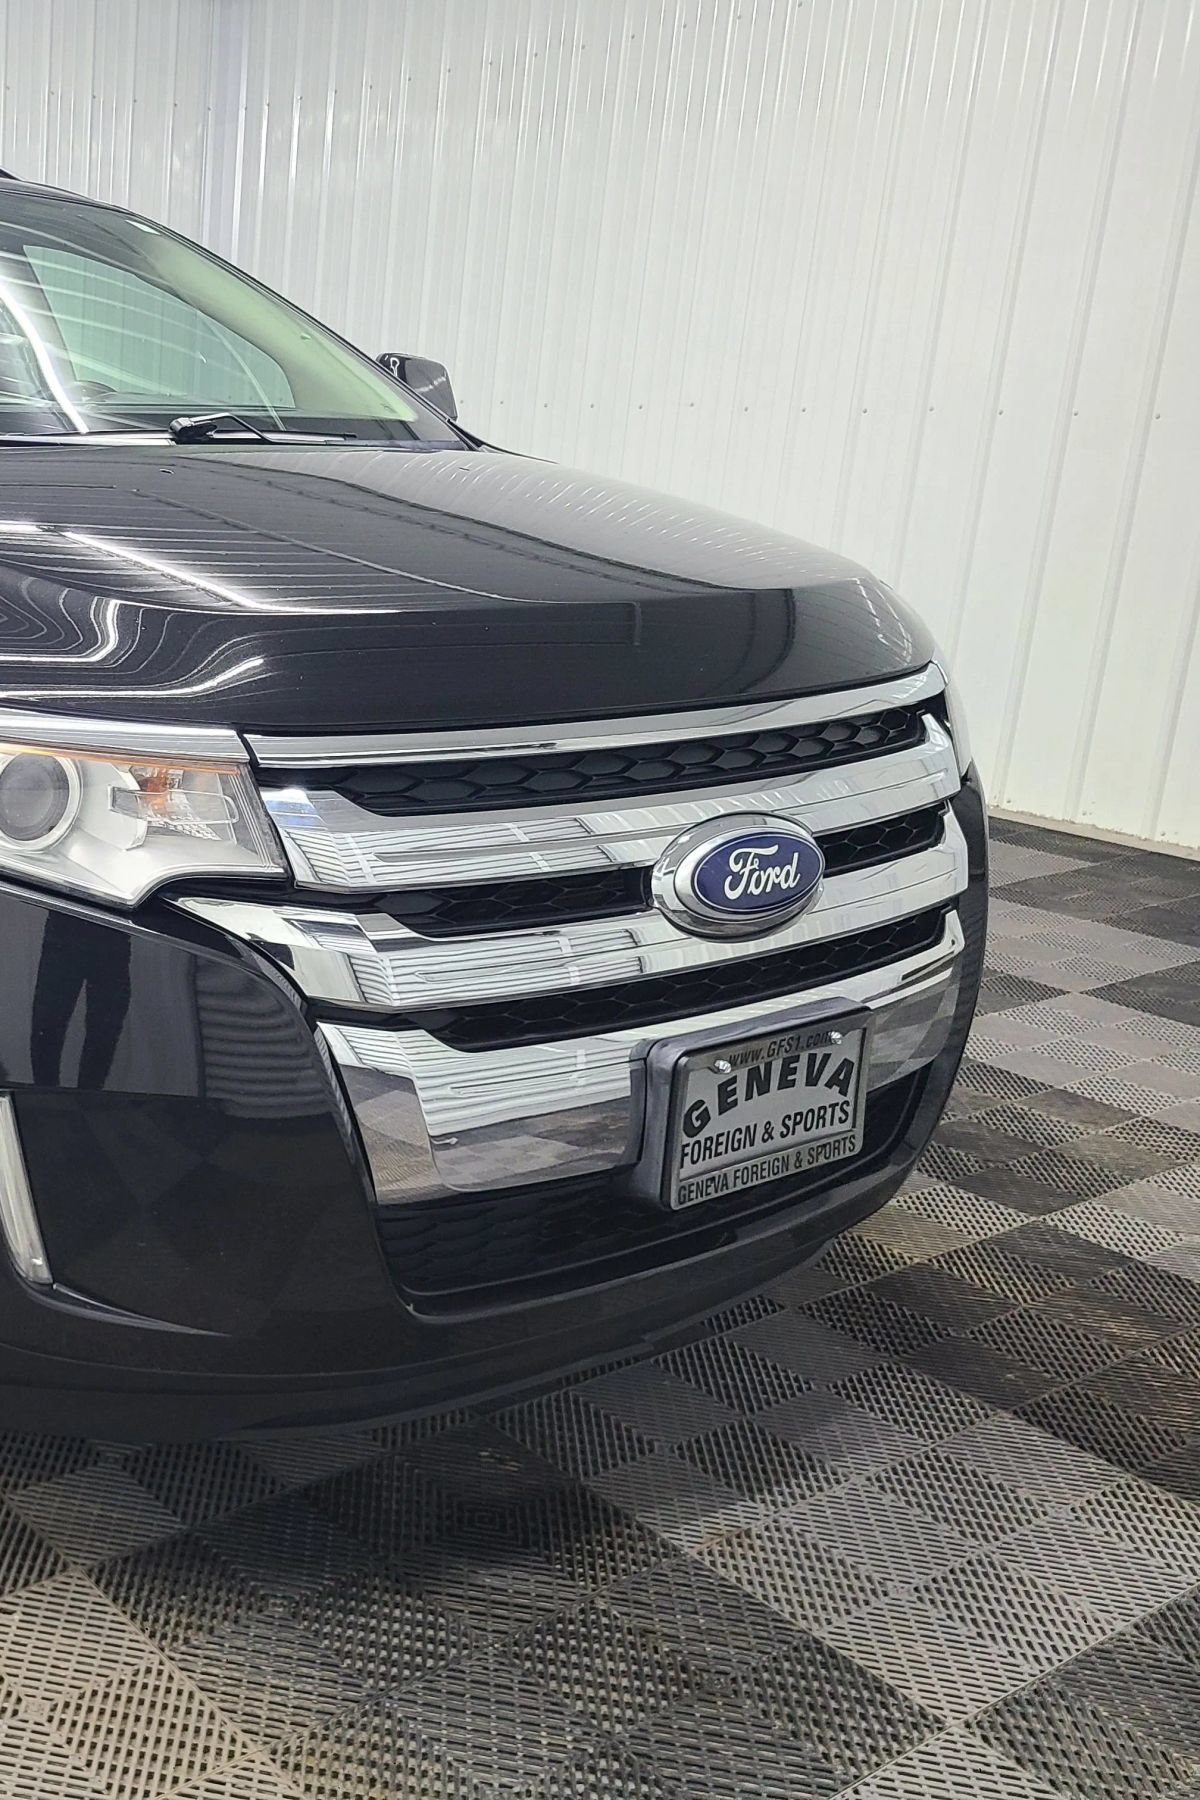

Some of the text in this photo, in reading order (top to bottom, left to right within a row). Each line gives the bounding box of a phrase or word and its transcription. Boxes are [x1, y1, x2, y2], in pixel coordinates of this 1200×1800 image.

[724, 844, 801, 900] Ford
[682, 1052, 855, 1138] GENEVA
[680, 1100, 850, 1169] FOREIGN & SPORTS
[677, 1134, 856, 1206] GENEVA FOREIGN & SPORTS
